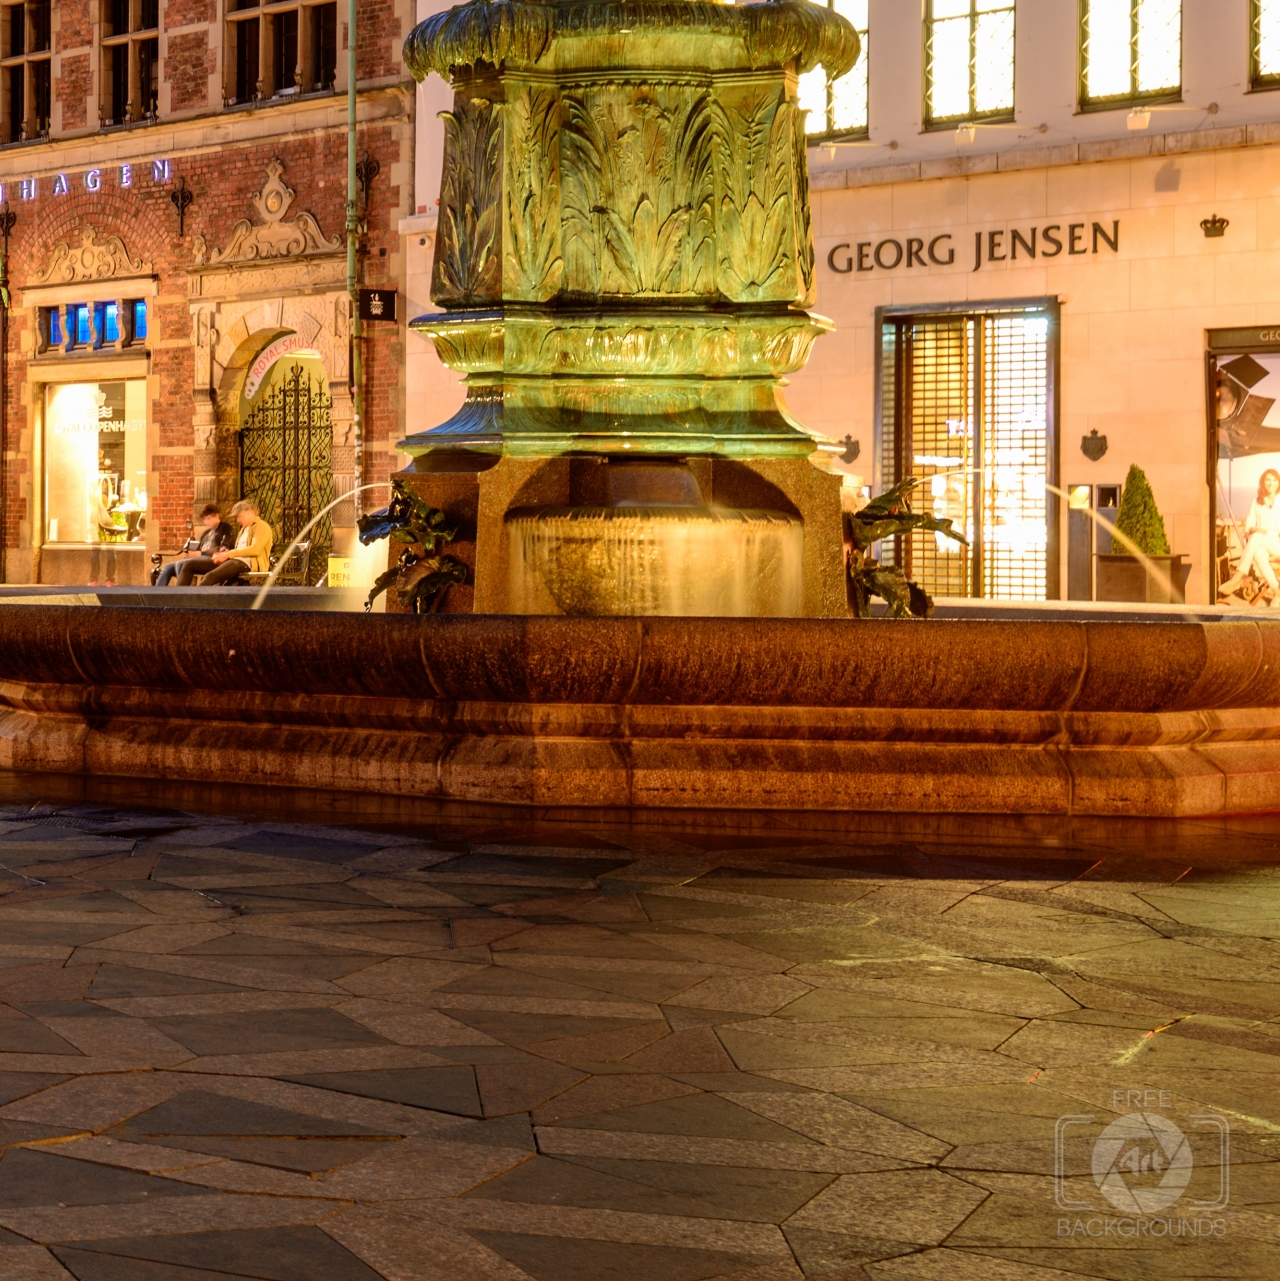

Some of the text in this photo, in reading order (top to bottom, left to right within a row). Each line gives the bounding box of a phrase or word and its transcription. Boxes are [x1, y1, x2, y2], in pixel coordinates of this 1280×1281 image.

[269, 190, 279, 212] 6
[827, 219, 1121, 274] GEORG JENSEN
[253, 336, 314, 379] ROYAL SMUS
[330, 573, 350, 581] REN
